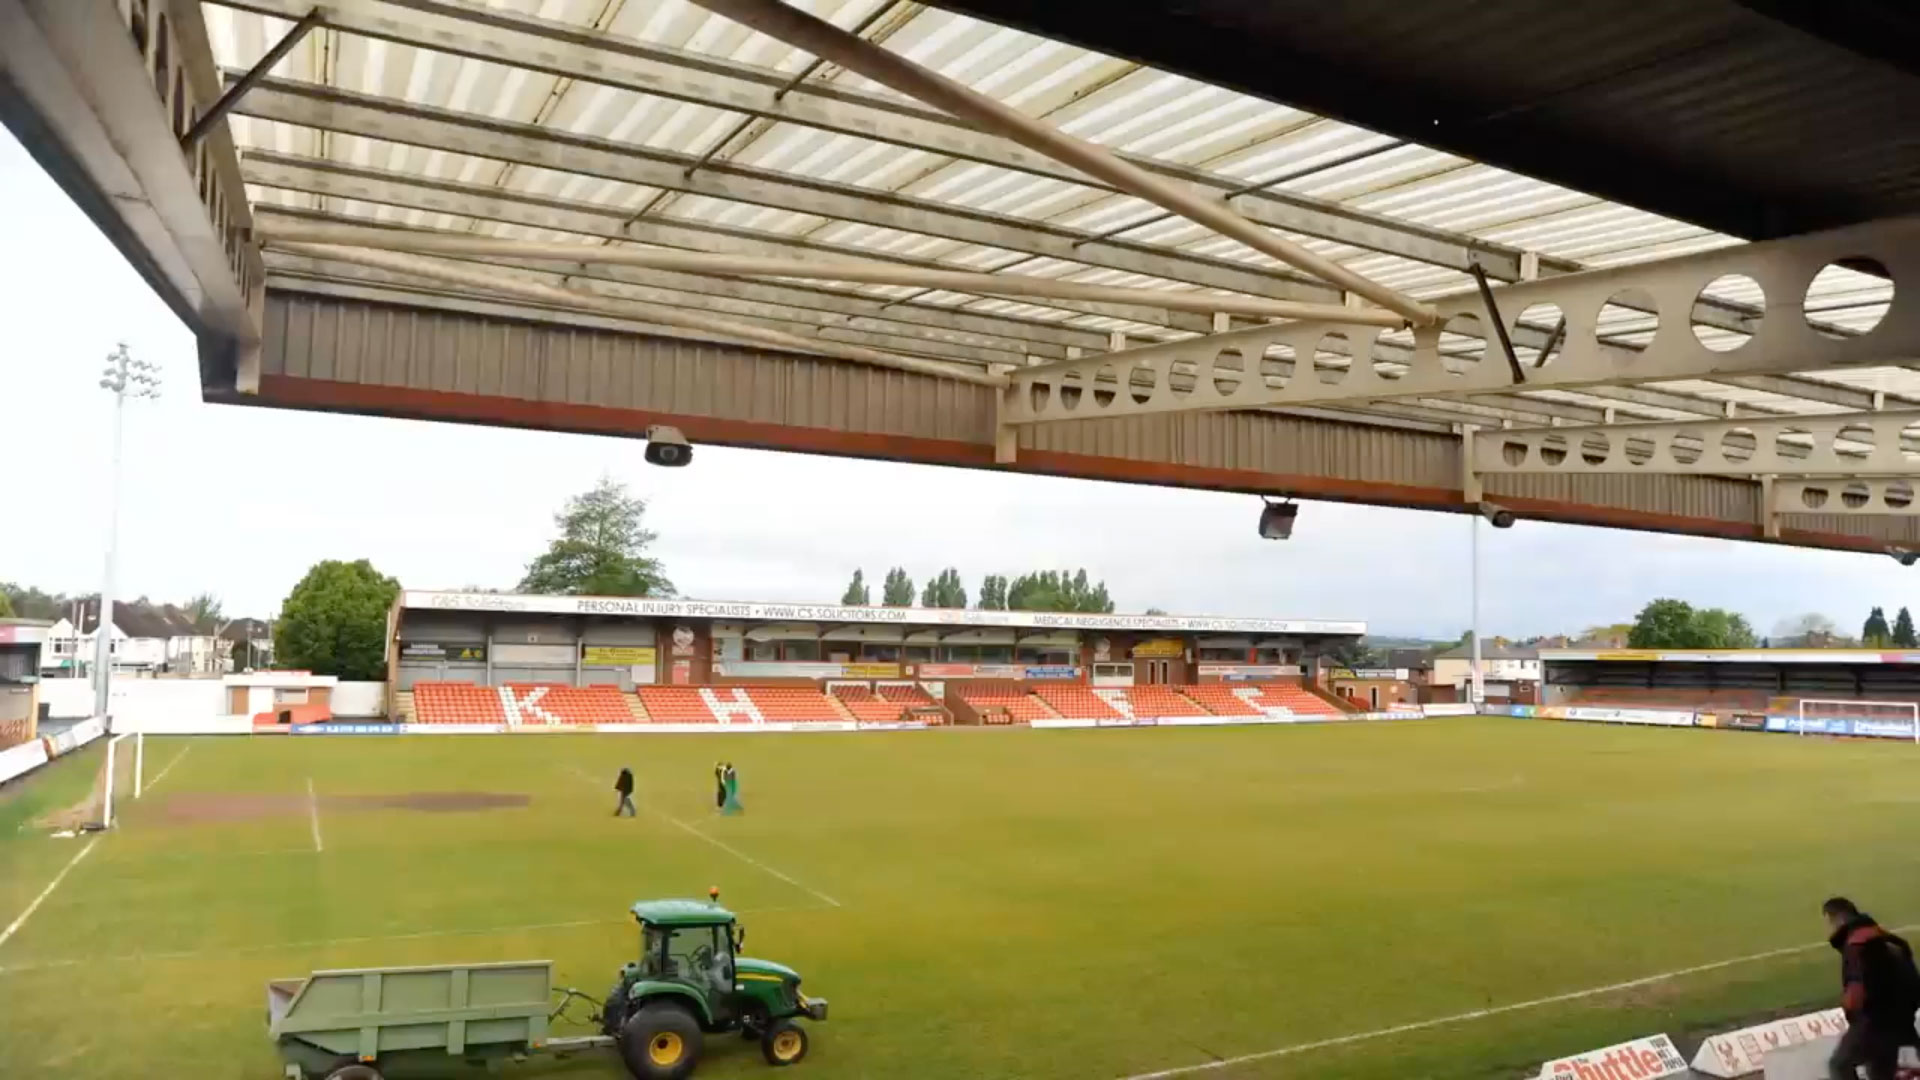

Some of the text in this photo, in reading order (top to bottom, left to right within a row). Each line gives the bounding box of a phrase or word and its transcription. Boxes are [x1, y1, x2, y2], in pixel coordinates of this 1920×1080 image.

[577, 600, 639, 613] PERSONAL
[642, 602, 682, 615] INJURY
[687, 604, 751, 616] SPECIALISTS
[1033, 615, 1073, 626] MEDICAL
[498, 686, 561, 726] K
